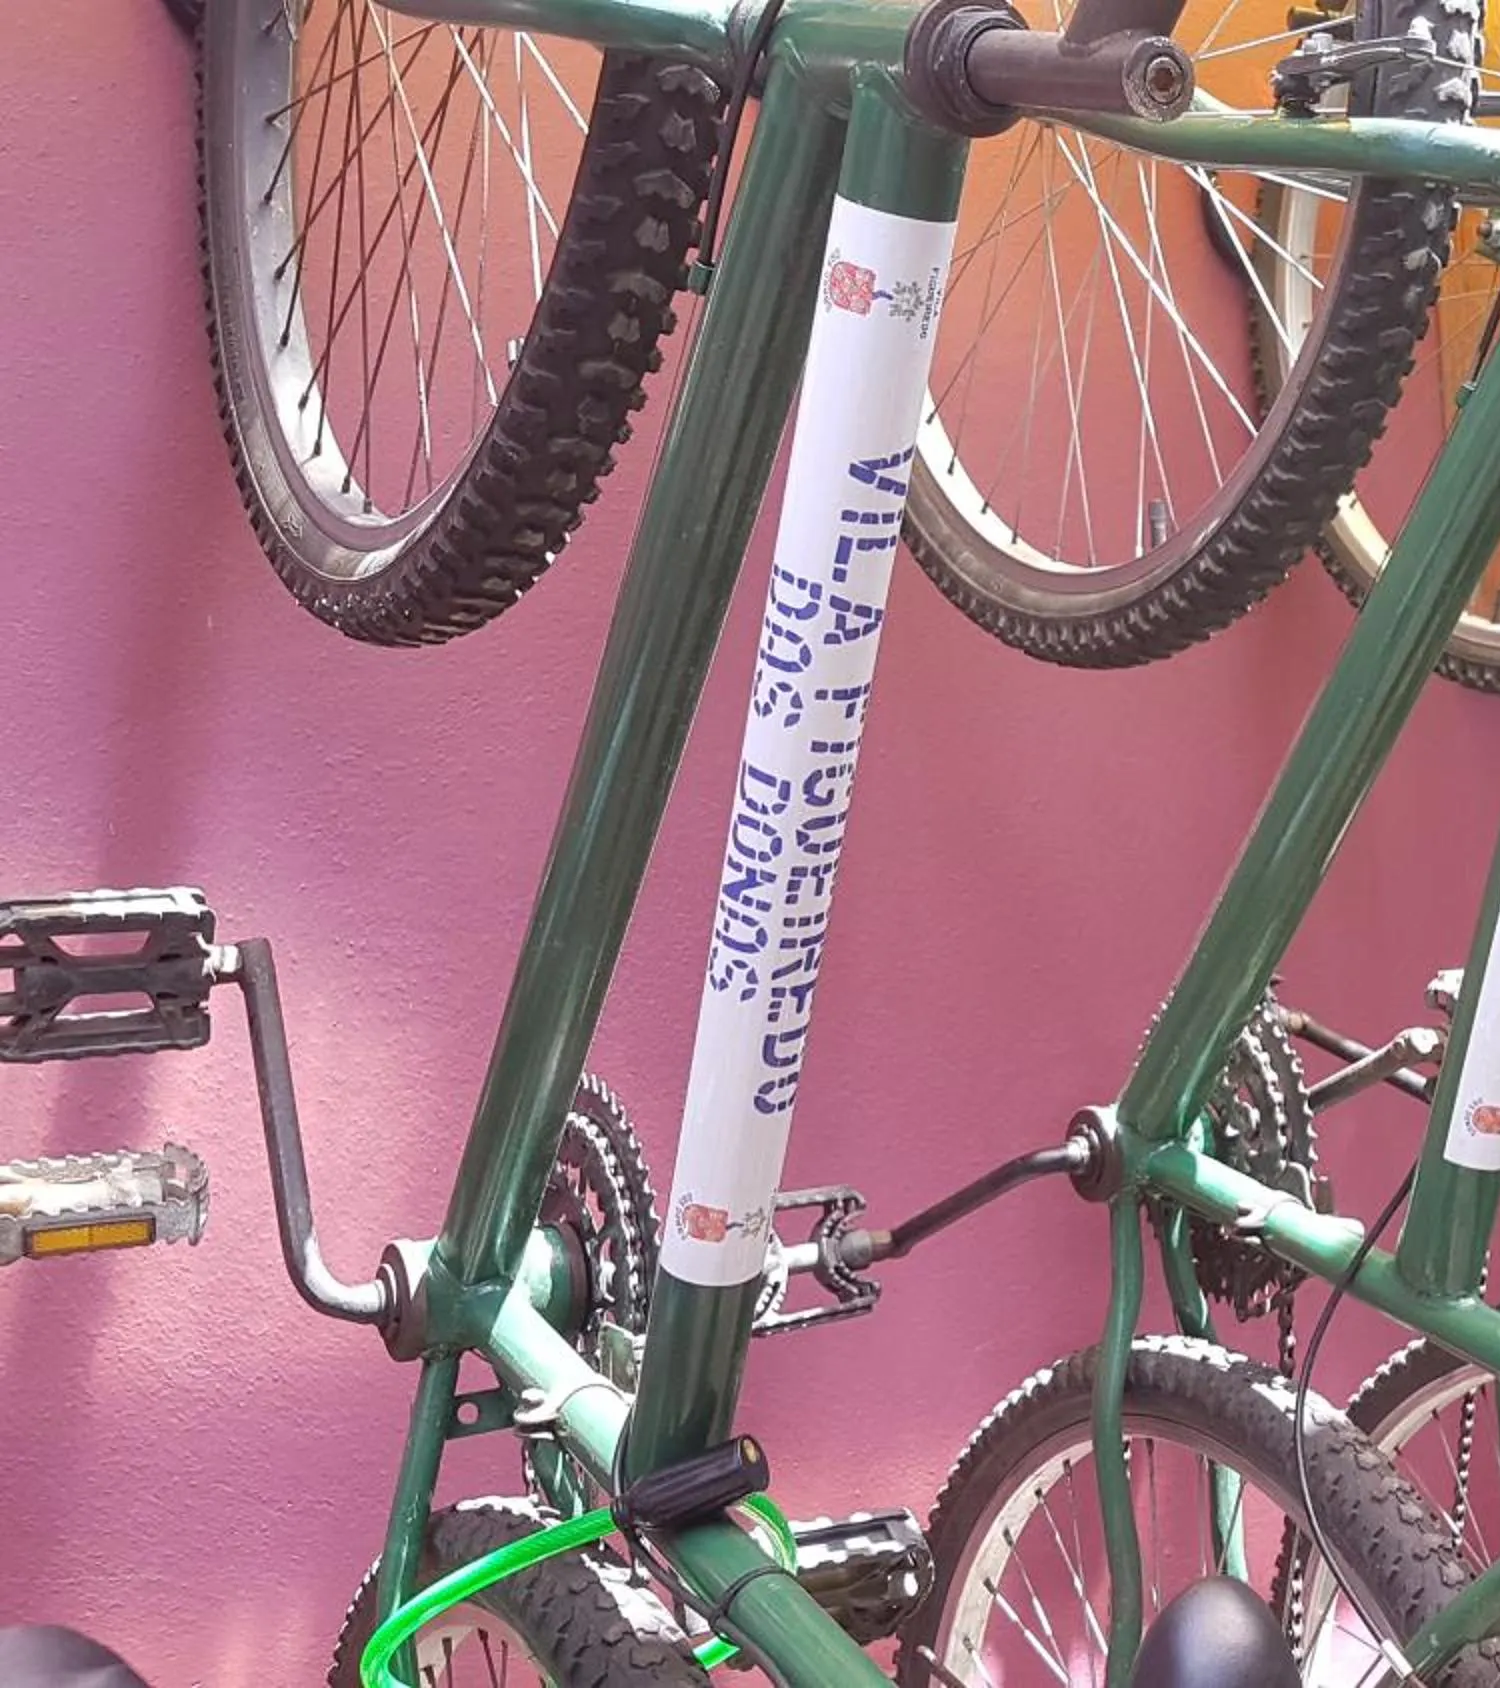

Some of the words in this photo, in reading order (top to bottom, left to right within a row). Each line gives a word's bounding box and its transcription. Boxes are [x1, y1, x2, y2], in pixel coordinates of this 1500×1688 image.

[752, 564, 823, 728] DAS
[824, 447, 914, 645] VILA
[708, 760, 791, 1001] DONAS
[753, 682, 871, 1114] FIGUEIREDO
